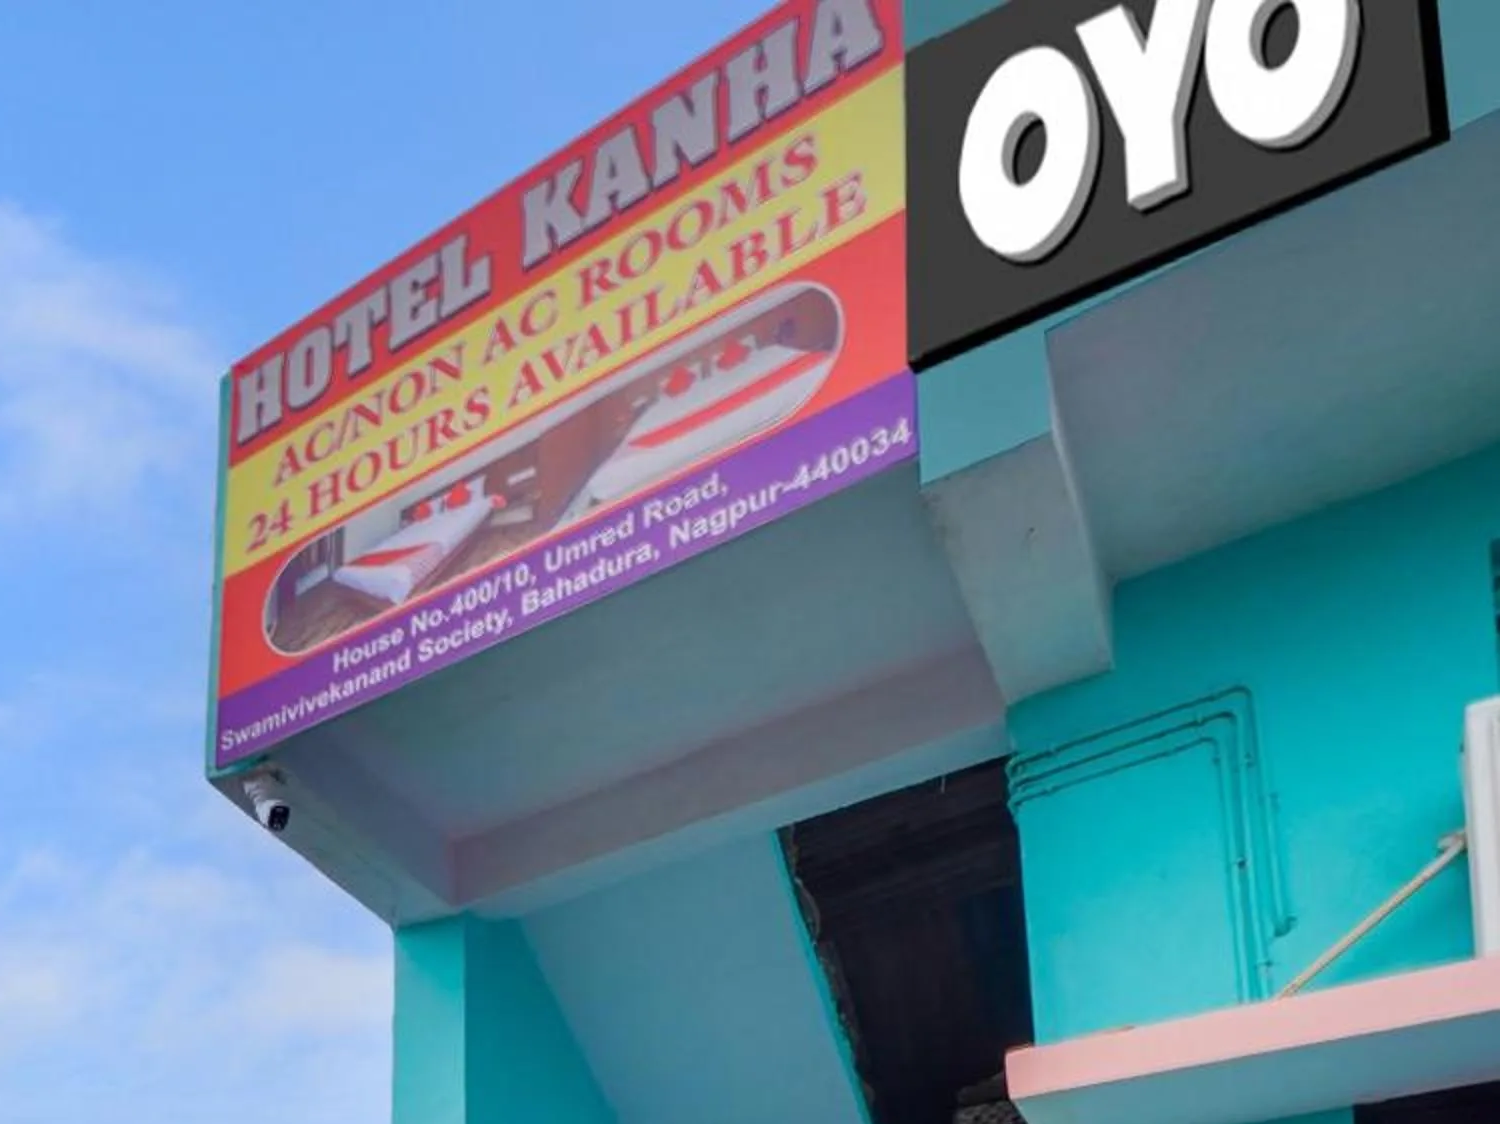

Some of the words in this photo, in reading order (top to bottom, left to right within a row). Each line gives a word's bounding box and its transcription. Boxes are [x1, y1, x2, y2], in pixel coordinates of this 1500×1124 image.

[237, 234, 492, 444] HOTEL
[522, 0, 883, 271] KANHA
[959, 0, 1362, 263] OYO
[246, 498, 294, 553] 24
[307, 385, 492, 518] HOURS
[507, 173, 868, 410] AVAILABLE
[273, 342, 466, 488] AC/NON
[483, 288, 561, 364] AC
[574, 134, 819, 306] ROOMS
[220, 653, 412, 751] Swamivivekanand
[416, 607, 514, 663] Society,
[520, 542, 661, 616] Bahadura,
[668, 417, 912, 549] Nagpur-440034
[332, 626, 405, 673] House
[543, 512, 635, 572] Umred
[642, 472, 729, 529] Road,
